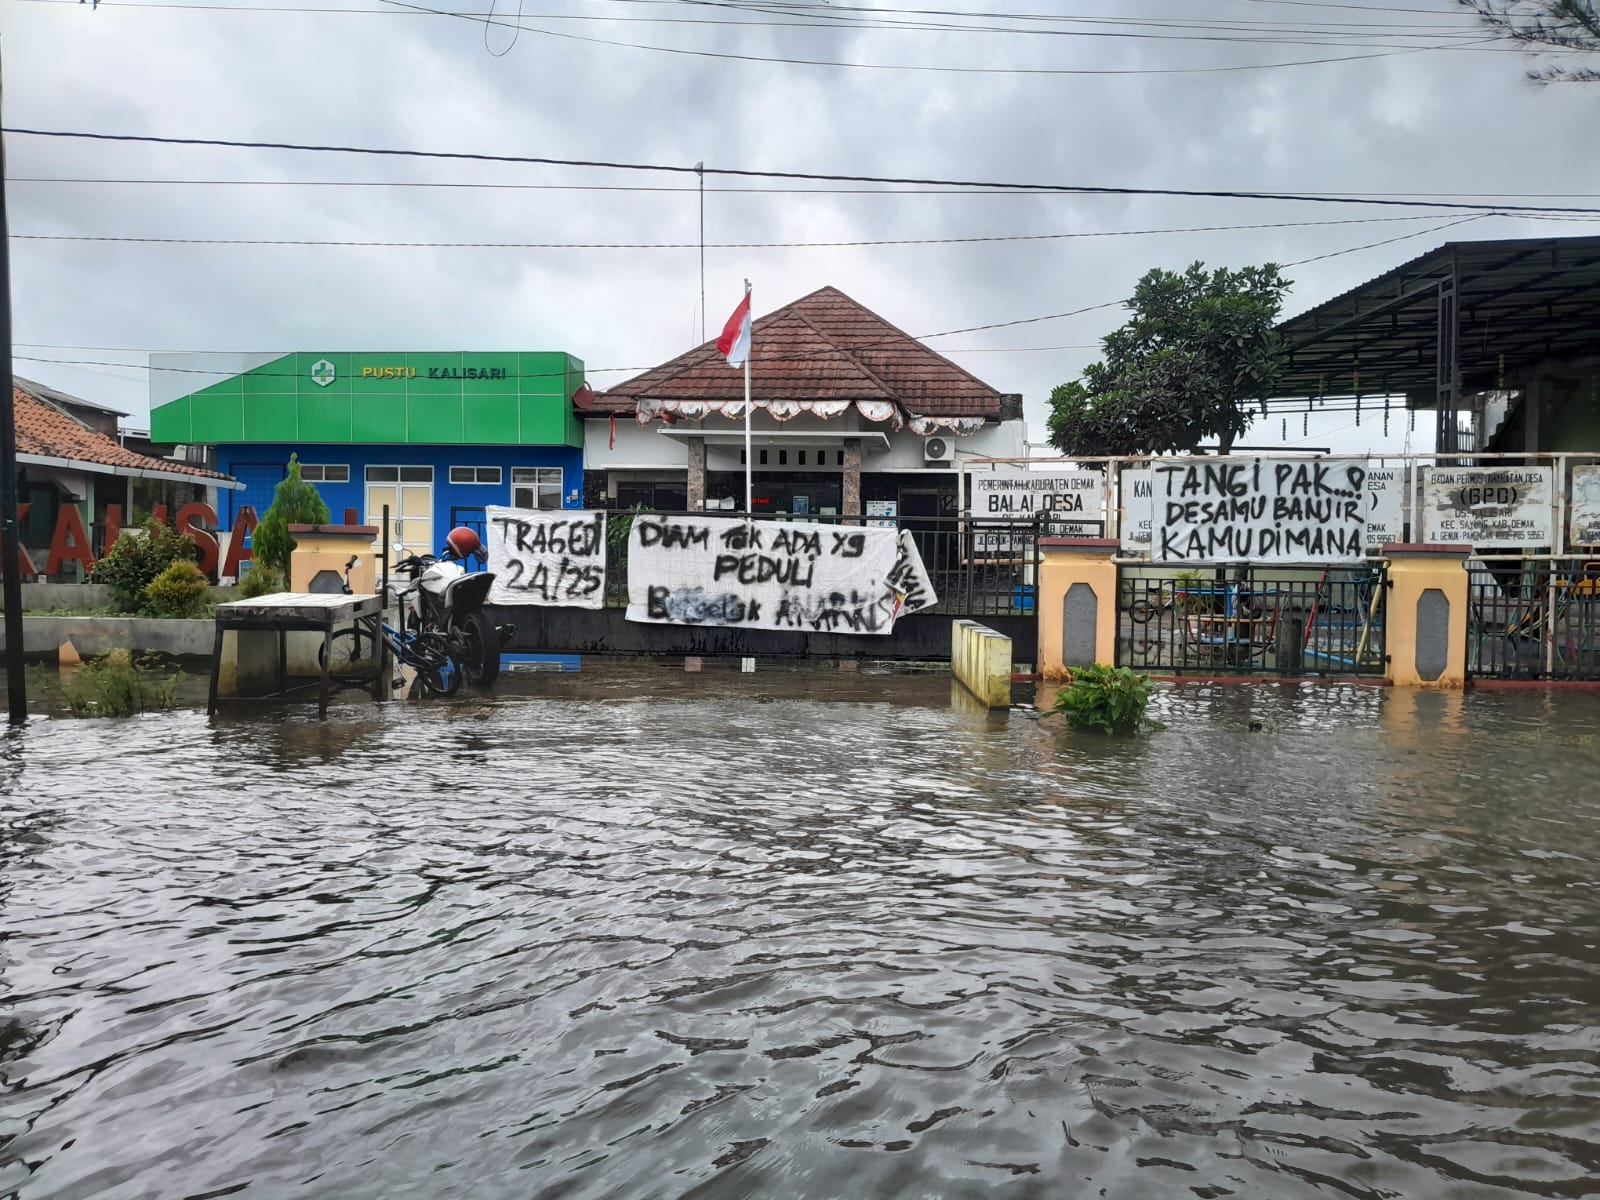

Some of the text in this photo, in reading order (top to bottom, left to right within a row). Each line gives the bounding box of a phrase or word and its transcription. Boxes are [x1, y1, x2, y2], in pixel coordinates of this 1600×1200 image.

[362, 366, 507, 380] PUSTU KALISARI
[978, 478, 1095, 491] PEMERINTAH KABUPATEN DEMAK
[1431, 473, 1455, 485] BADAN
[1525, 472, 1543, 484] DESA
[988, 493, 1084, 512] BALAI DESA
[1459, 486, 1518, 505] (BPD)
[1060, 524, 1084, 534] DEMAK
[1440, 520, 1459, 530] KEC.
[1511, 520, 1535, 529] DEMAK
[771, 528, 822, 556] ADA
[505, 557, 604, 603] 24/25
